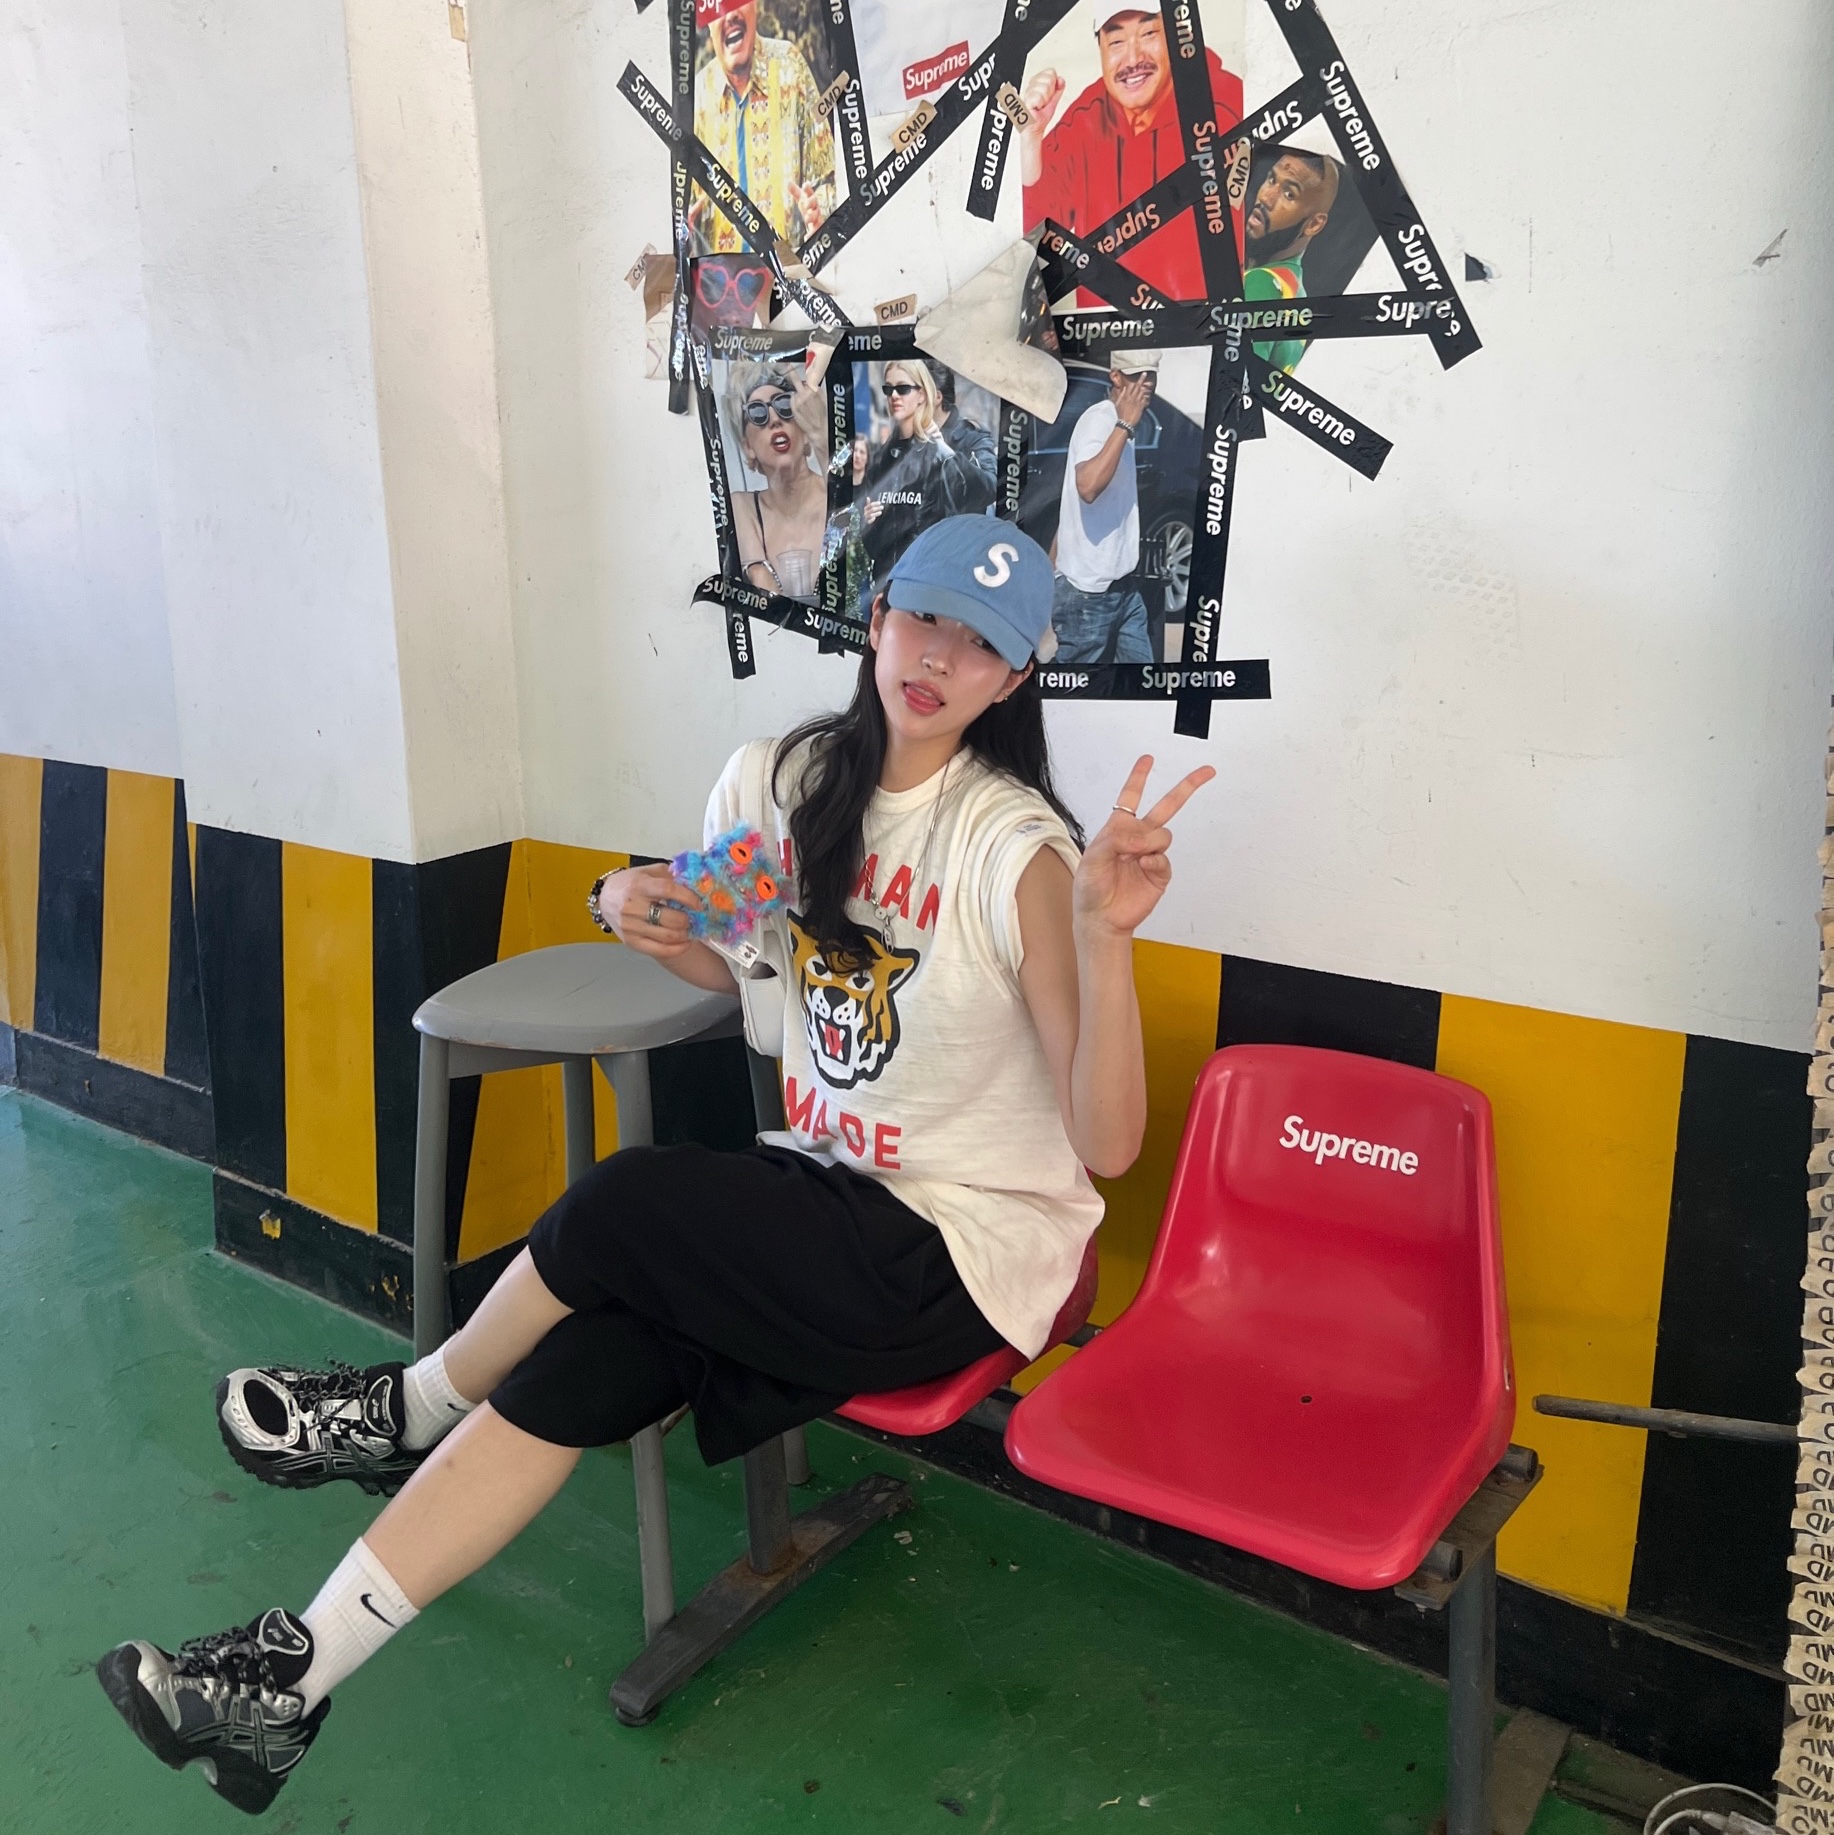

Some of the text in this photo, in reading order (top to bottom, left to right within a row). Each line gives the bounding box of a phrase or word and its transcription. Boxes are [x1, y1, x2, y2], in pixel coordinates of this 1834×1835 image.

[817, 85, 841, 116] CMD
[958, 53, 995, 100] Supr
[630, 74, 682, 141] Supreme
[842, 79, 868, 179] Supreme
[899, 112, 927, 144] CMD
[1004, 93, 1028, 125] CMD
[1319, 60, 1380, 171] Supreme
[860, 132, 927, 206] Supreme
[981, 101, 1007, 190] preme
[707, 163, 760, 234] Supreme
[1191, 120, 1224, 234] Supreme
[1229, 156, 1250, 198] CMD
[1042, 230, 1089, 269] reme
[1097, 203, 1160, 254] Supre
[881, 302, 907, 319] CMD
[1062, 316, 1154, 346] Supreme
[1209, 306, 1313, 331] Supreme
[1375, 295, 1453, 328] Supre
[714, 330, 773, 354] Supreme
[1261, 370, 1355, 446] Supreme
[710, 438, 728, 526] Supreme
[1003, 410, 1028, 512] Supreme
[1206, 424, 1237, 536] Supreme
[973, 543, 1019, 588] S
[702, 578, 768, 611] Supreme
[732, 612, 749, 663] reme
[1189, 595, 1219, 662] Supre
[1038, 671, 1089, 688] reme
[1141, 665, 1236, 695] Supreme
[786, 1075, 901, 1170] MADE
[1279, 1115, 1419, 1175] Supreme
